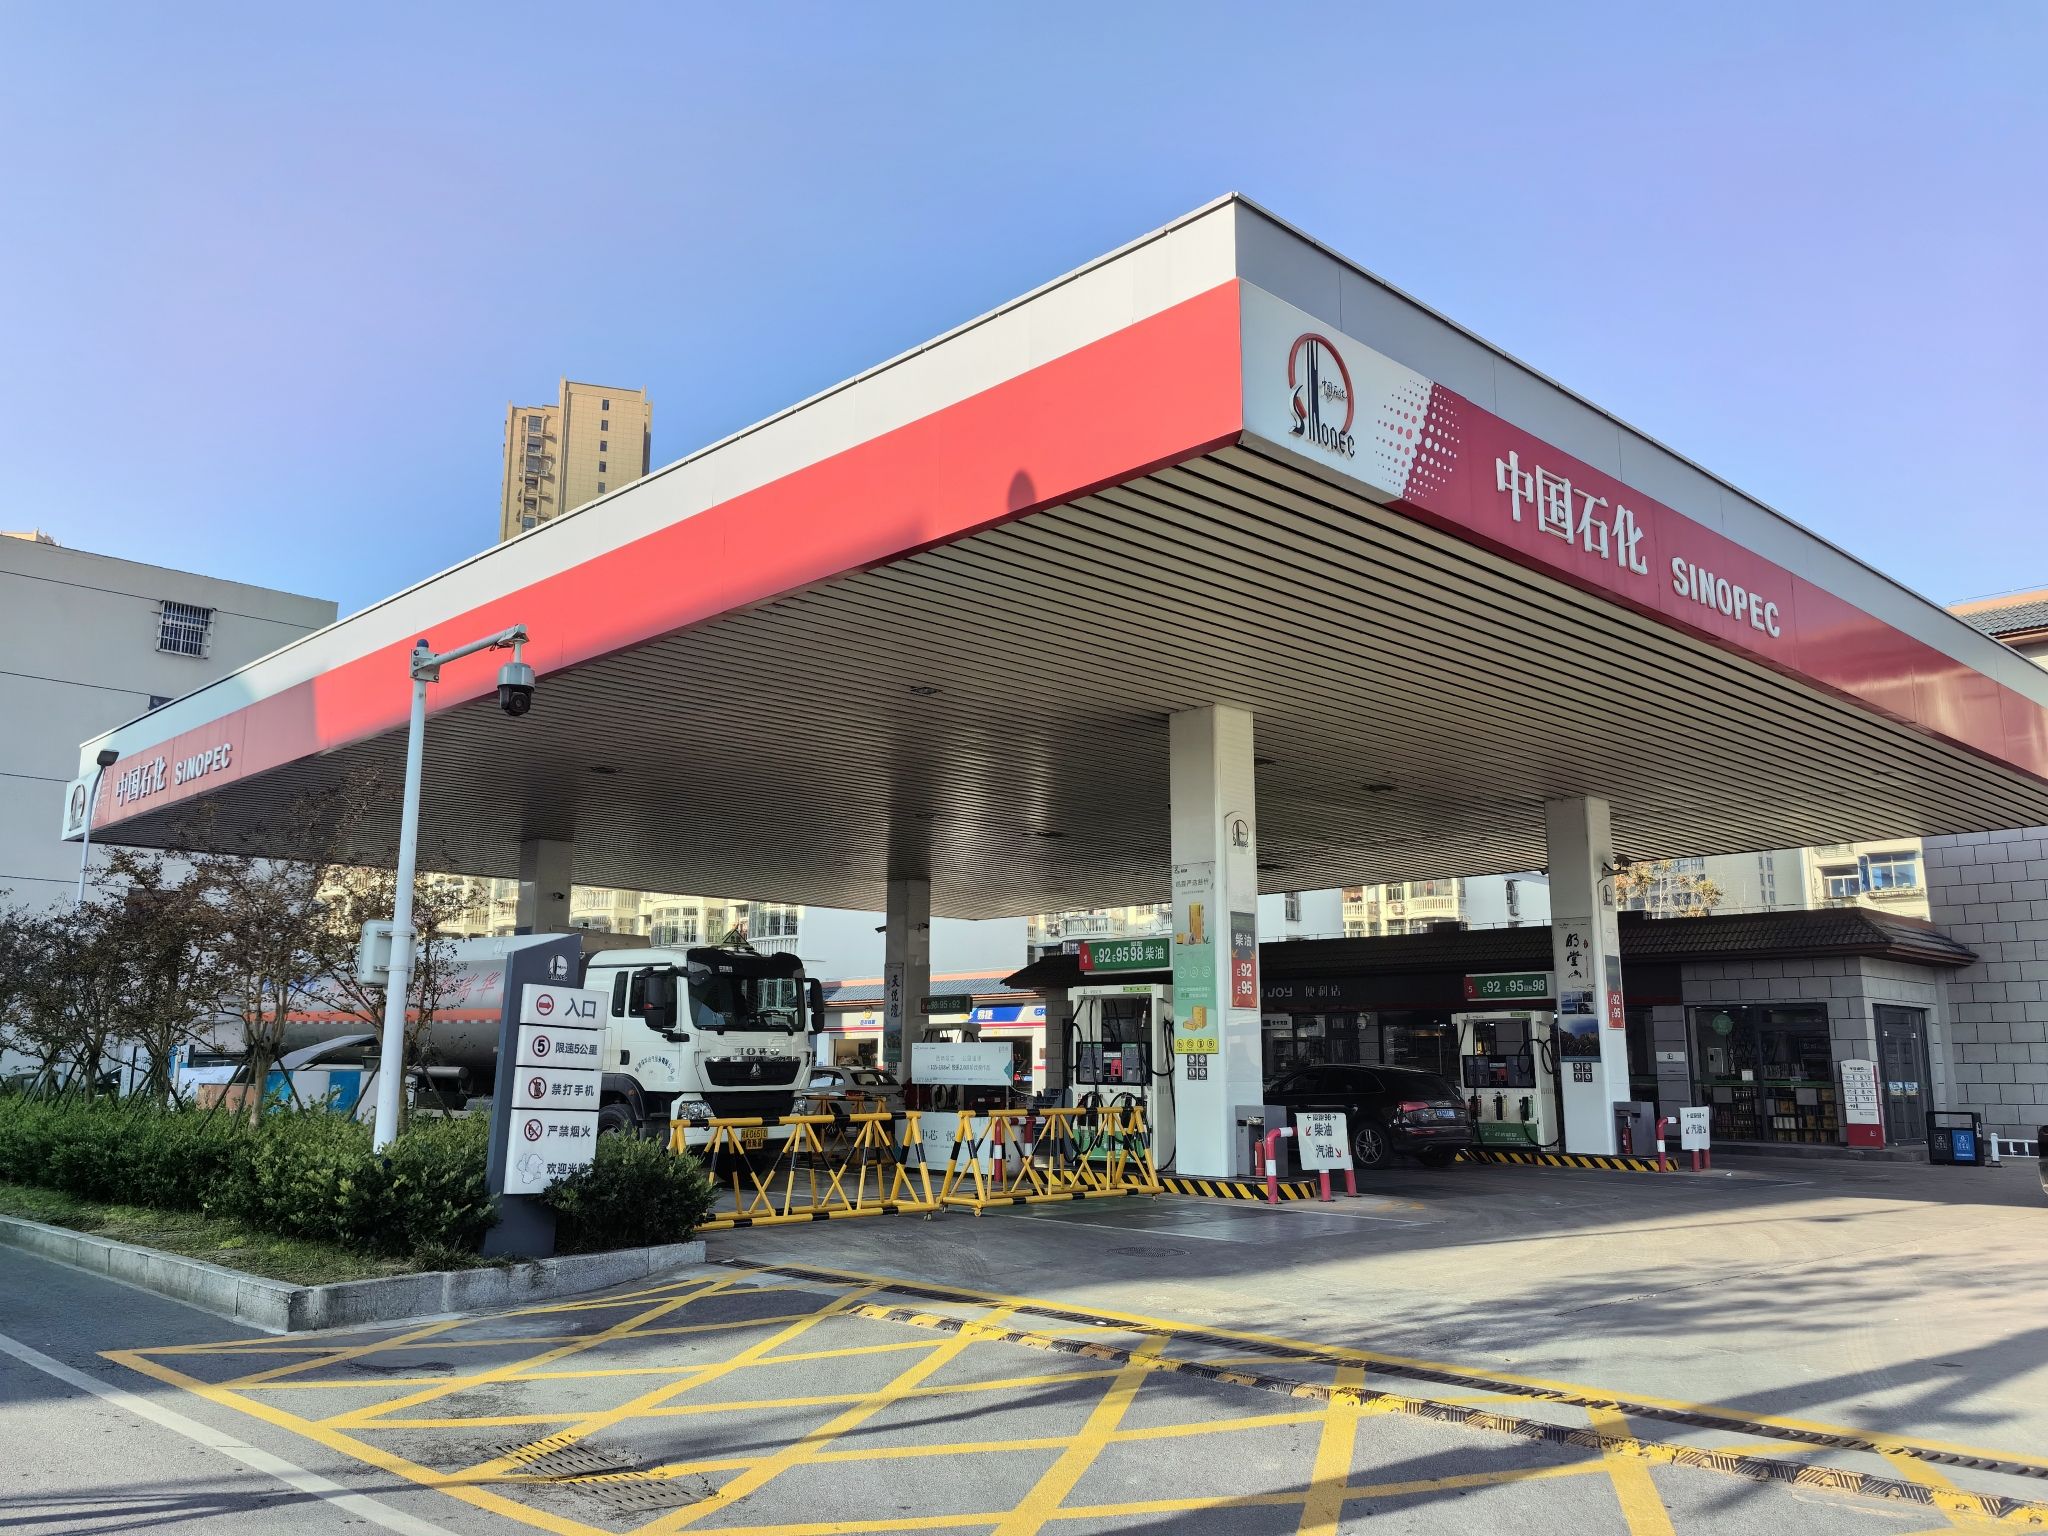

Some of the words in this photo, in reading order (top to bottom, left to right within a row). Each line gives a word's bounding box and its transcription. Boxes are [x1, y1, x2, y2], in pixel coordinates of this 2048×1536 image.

[1496, 451, 1648, 575] 中国石化
[1672, 557, 1780, 638] SINOPEC
[116, 756, 168, 807] 中国石化
[175, 743, 233, 785] SINOPEC
[1235, 932, 1252, 947] 柴油
[1083, 955, 1087, 964] 1
[1095, 948, 1111, 963] E92
[1112, 947, 1129, 962] E95
[1130, 947, 1144, 961] 98
[1145, 945, 1164, 960] 柴油
[1237, 962, 1252, 977] E92
[1237, 981, 1252, 995] E95
[1268, 986, 1293, 997] JOY
[1483, 981, 1500, 993] E92
[564, 998, 597, 1019] 入口
[537, 1039, 546, 1053] 5
[555, 1042, 598, 1056] 限速5公里
[551, 1083, 595, 1096] 禁打手机
[547, 1125, 591, 1138] 严禁烟火
[1314, 1123, 1333, 1137] 柴油
[1315, 1144, 1334, 1158] 汽油
